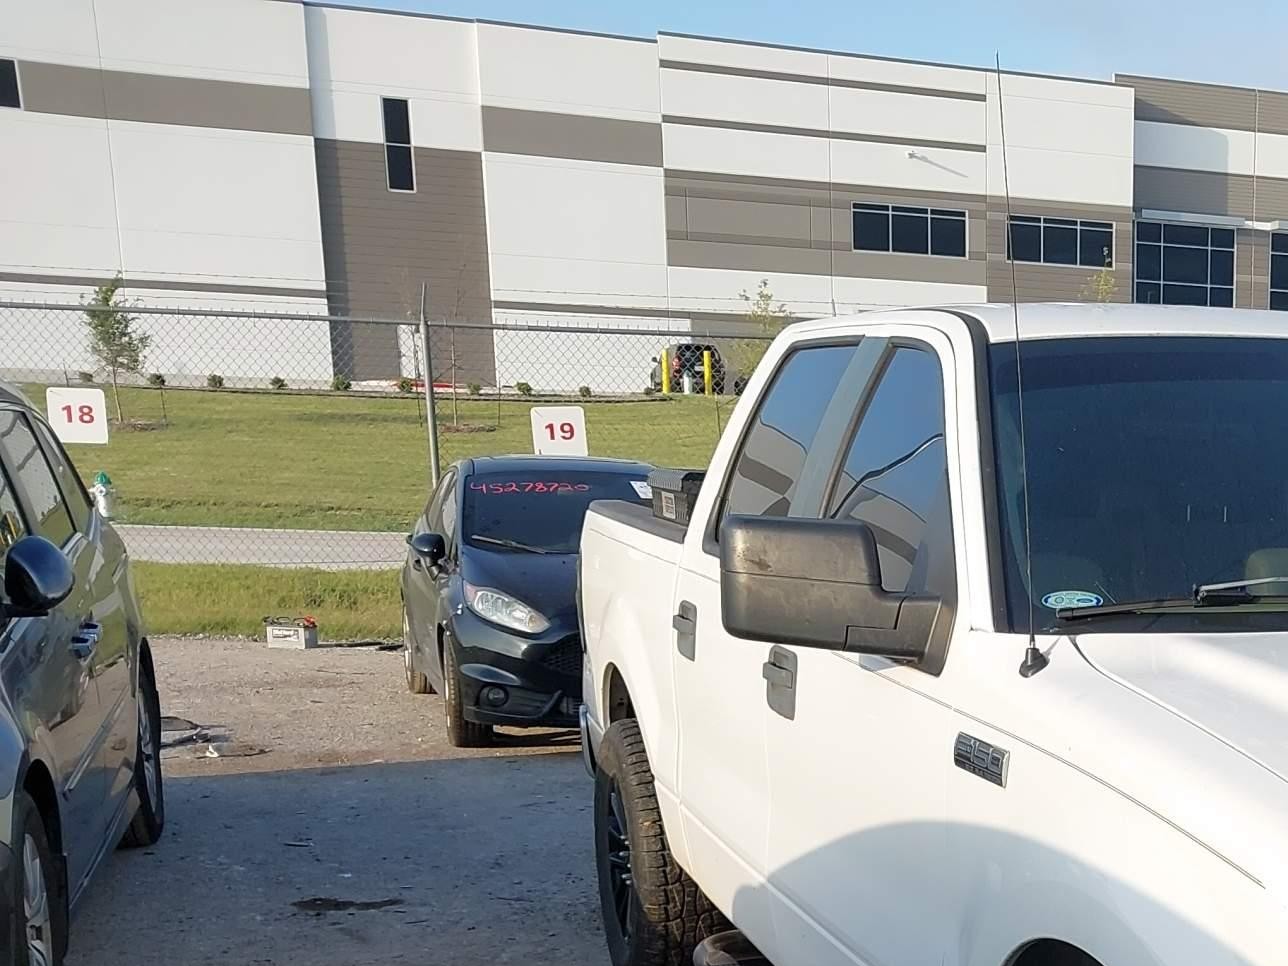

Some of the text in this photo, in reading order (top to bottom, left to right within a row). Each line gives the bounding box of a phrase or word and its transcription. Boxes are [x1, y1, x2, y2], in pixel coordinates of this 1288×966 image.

[61, 405, 95, 424] 18
[544, 422, 575, 441] 19
[470, 481, 590, 495] 45278720
